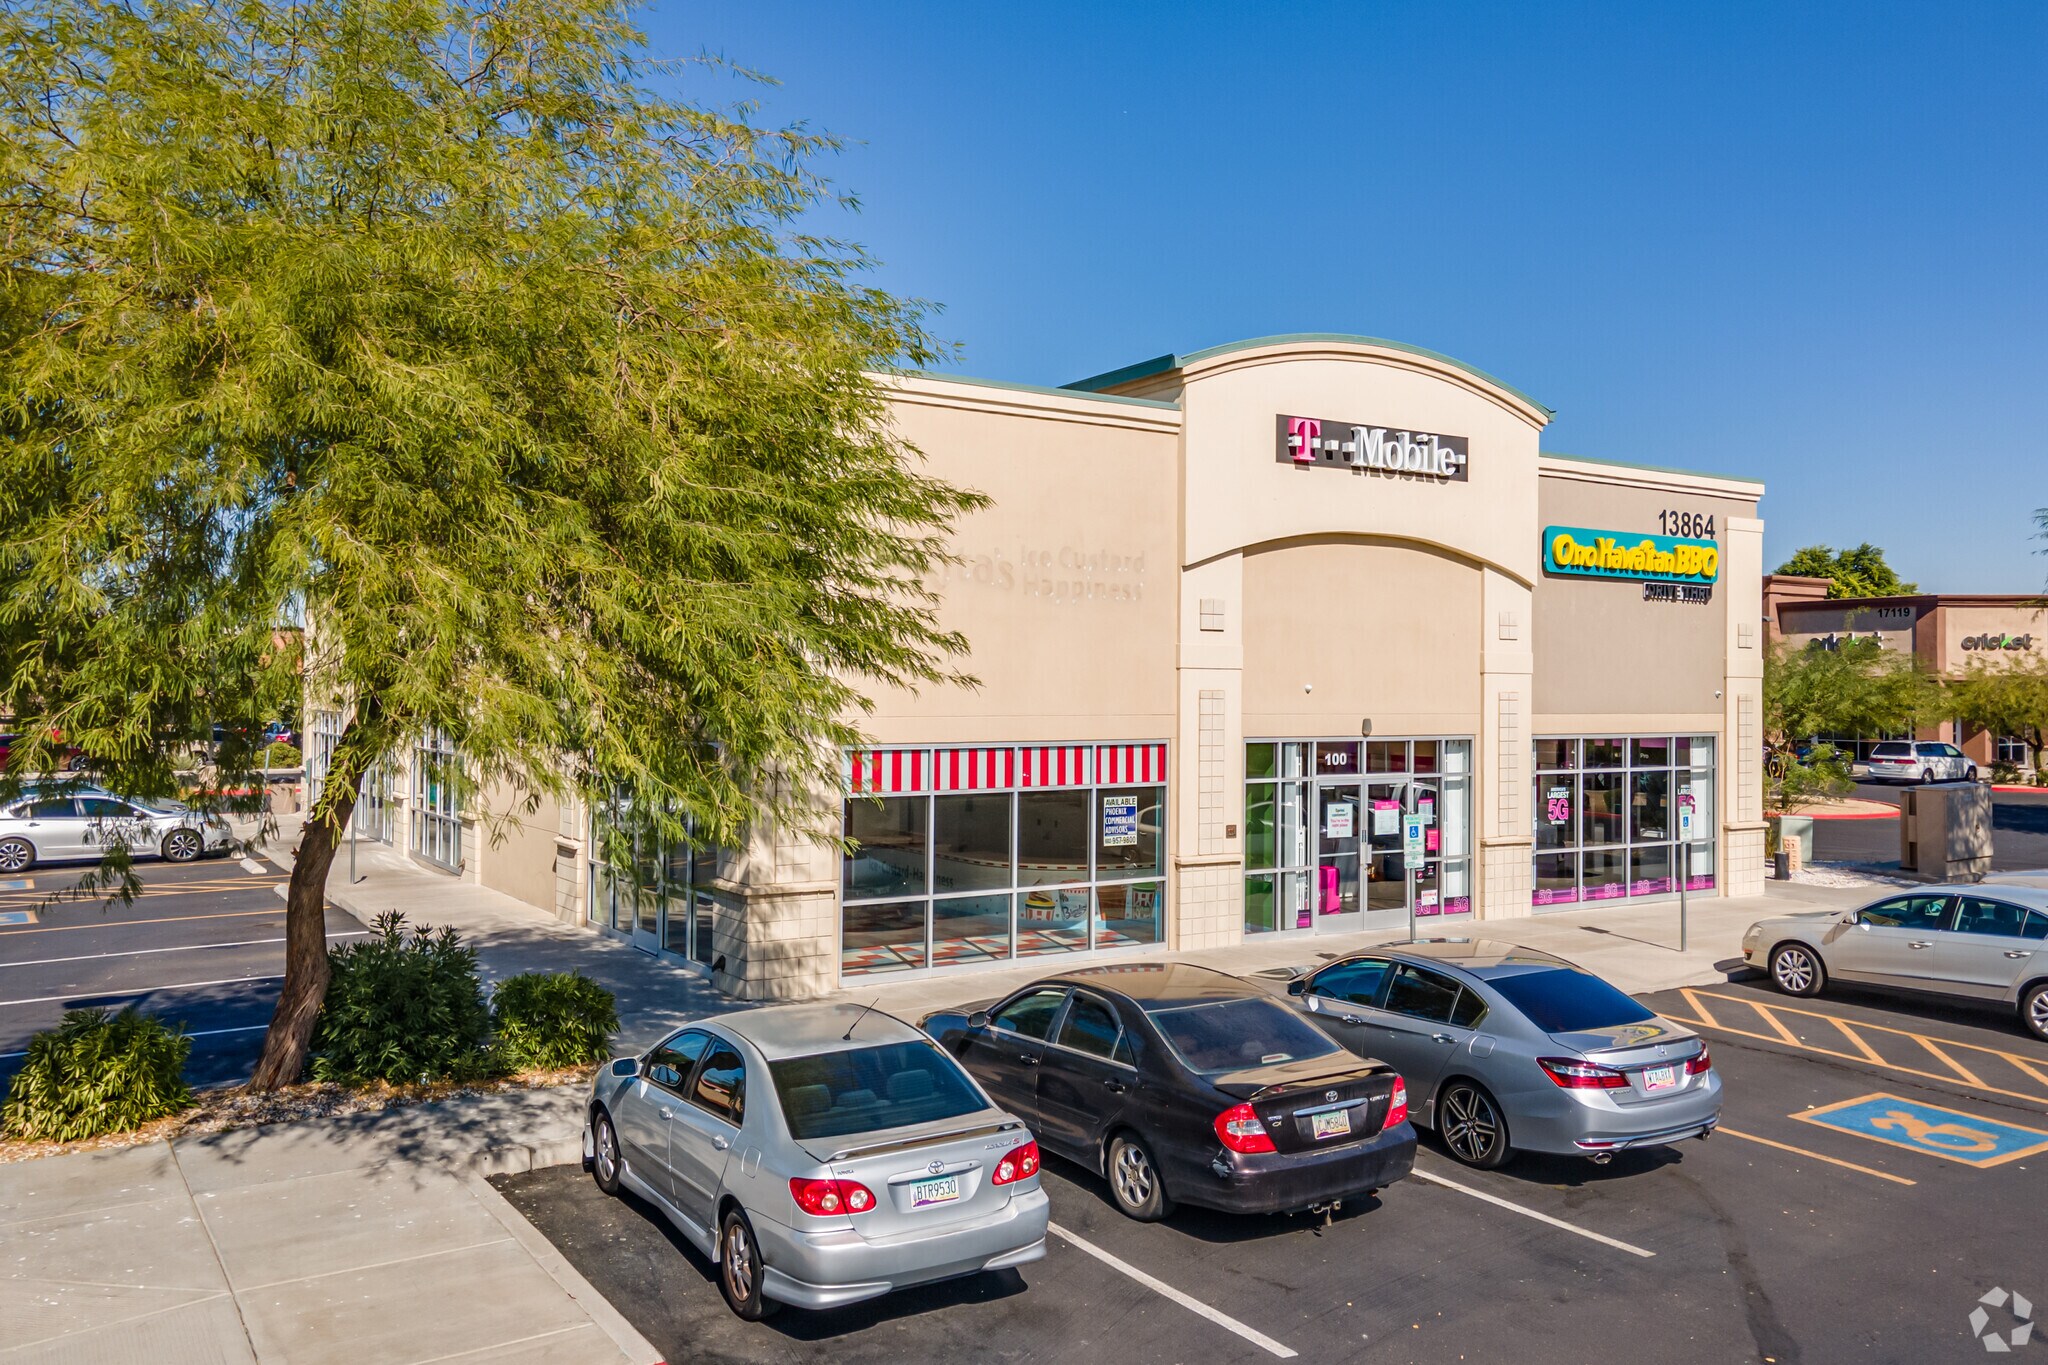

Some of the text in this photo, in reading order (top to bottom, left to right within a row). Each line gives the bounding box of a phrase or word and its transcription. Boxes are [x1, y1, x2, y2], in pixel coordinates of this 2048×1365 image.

[1658, 509, 1716, 540] 13864
[1552, 533, 1597, 567] Ono
[1673, 545, 1718, 577] BBQ
[1878, 607, 1911, 618] 17119
[1961, 632, 2033, 651] cricket
[1325, 752, 1347, 766] 100
[1105, 798, 1136, 806] AVAILABLE
[1548, 798, 1569, 820] 5G
[1105, 808, 1127, 816] PHOENIX
[1105, 816, 1136, 825] COMMERCIAL
[1105, 826, 1128, 834] ADVISORS
[1605, 883, 1618, 898] 5G
[1637, 880, 1650, 894] 5G
[1454, 896, 1469, 912] 5G
[1539, 889, 1553, 905] 5G
[916, 1180, 957, 1201] BTR9530
